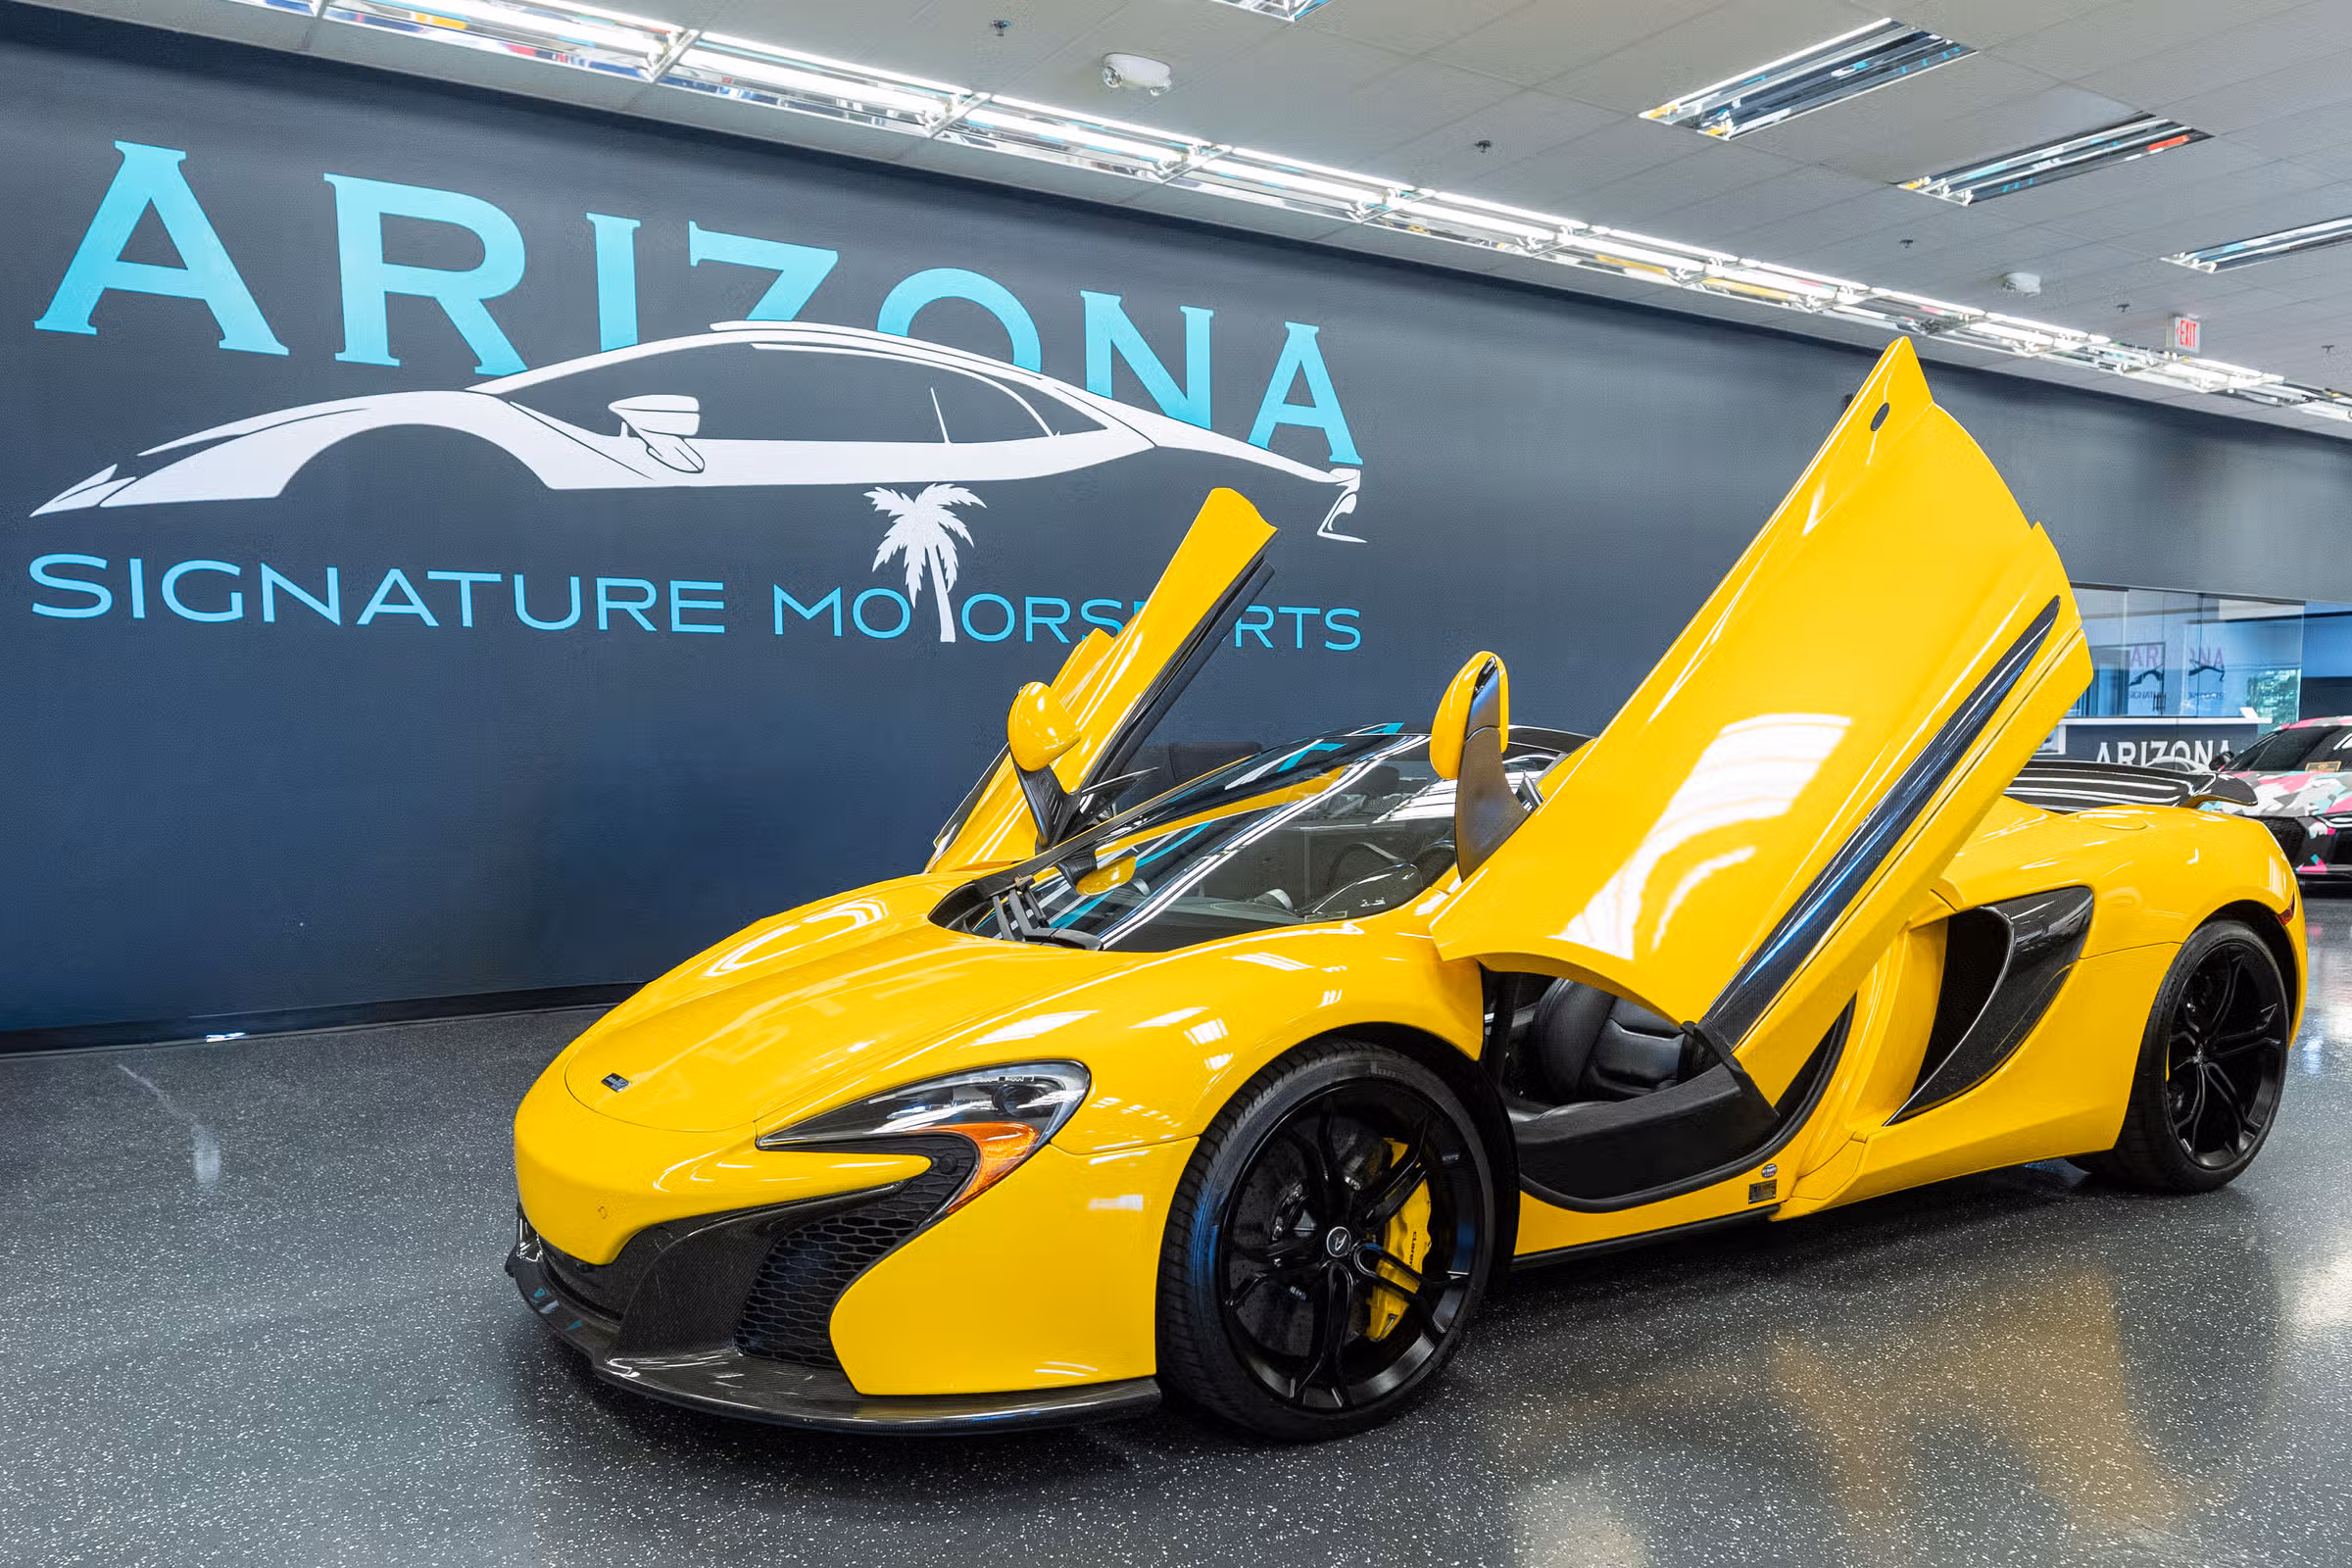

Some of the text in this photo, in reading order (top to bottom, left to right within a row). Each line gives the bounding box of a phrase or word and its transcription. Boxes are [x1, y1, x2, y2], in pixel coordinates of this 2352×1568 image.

[33, 140, 1363, 466] ARIZONA
[2180, 319, 2197, 347] EXIT
[28, 553, 1362, 652] SIGNATURE MOTORSRTS
